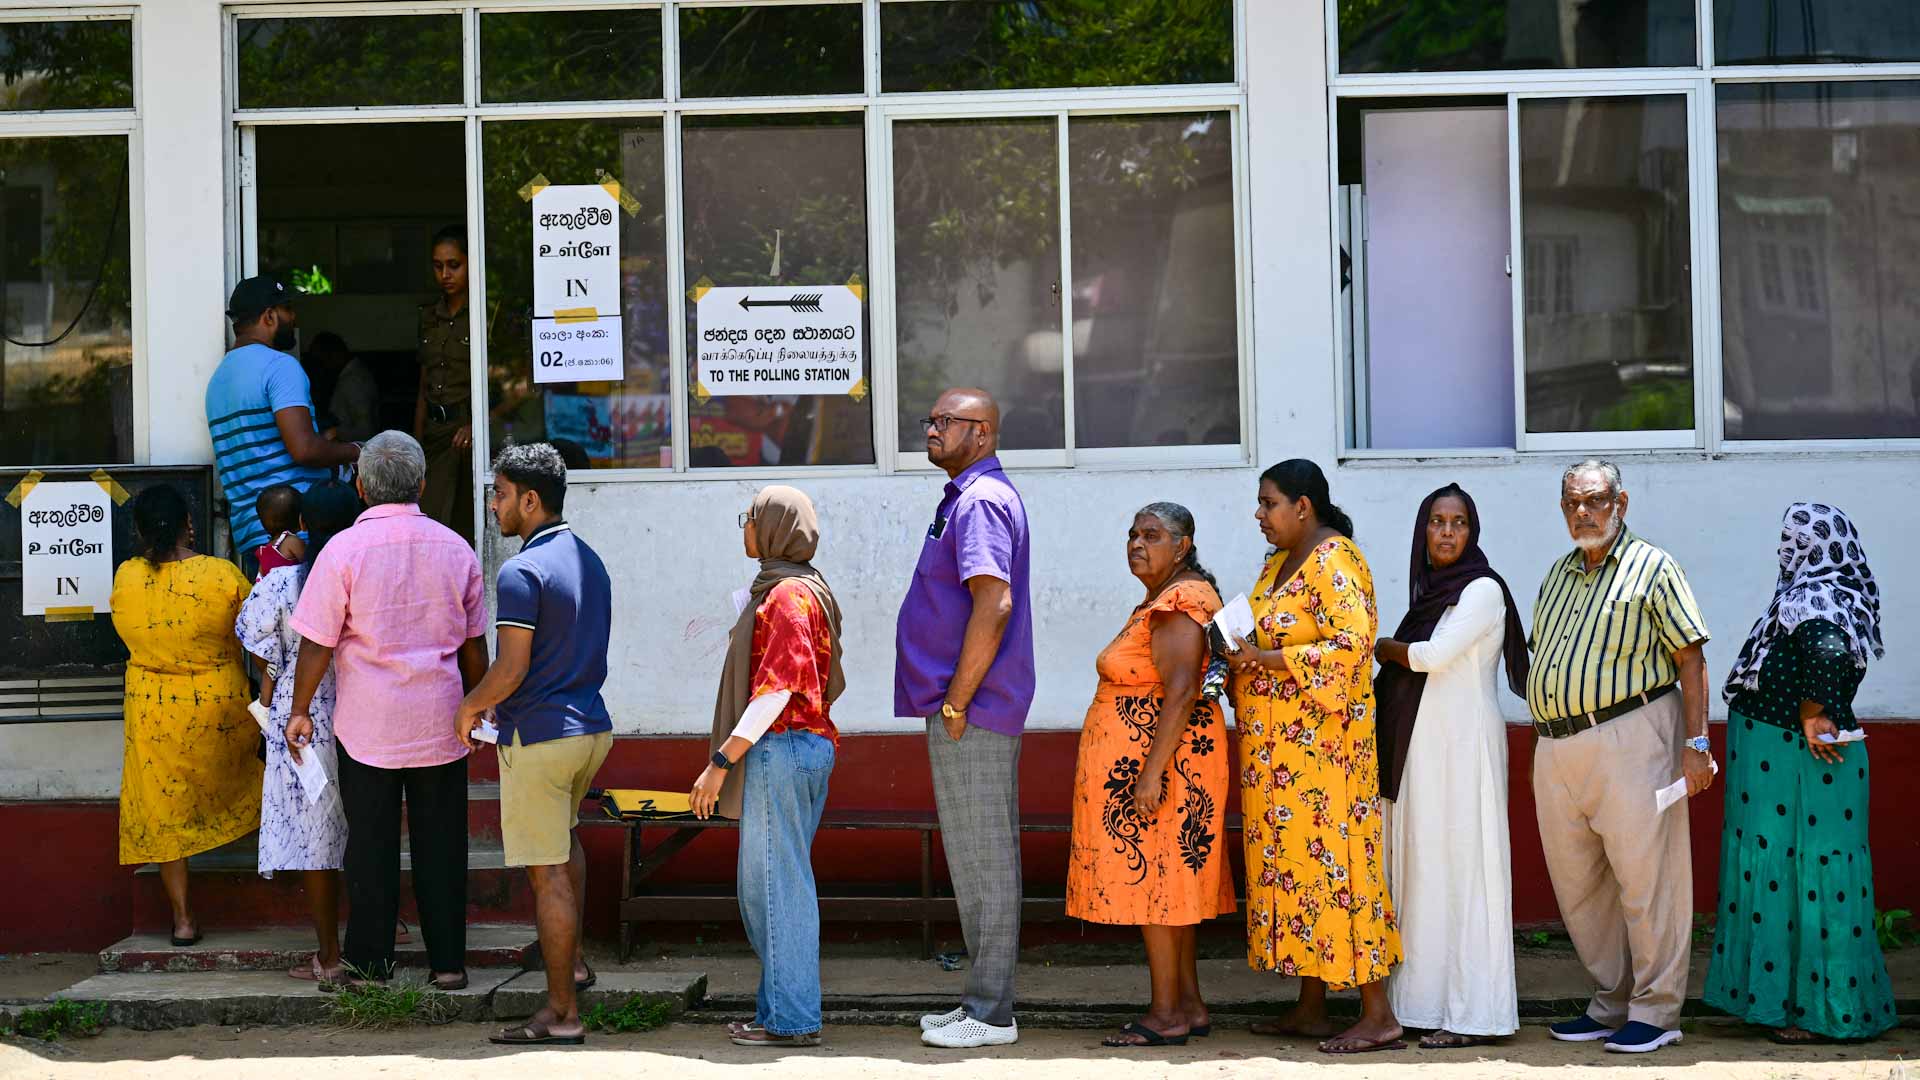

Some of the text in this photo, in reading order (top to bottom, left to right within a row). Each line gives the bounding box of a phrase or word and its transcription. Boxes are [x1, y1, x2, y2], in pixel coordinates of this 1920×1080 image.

[539, 207, 612, 231] ඇතුල්වීම
[539, 241, 611, 259] உள்ளே
[566, 279, 588, 297] IN
[539, 329, 572, 341] ශාලා
[704, 327, 748, 345] ඡන්දය
[754, 328, 786, 344] දෙන
[540, 351, 563, 367] 02
[702, 348, 773, 363] வாக்கெடுப்பு
[709, 368, 849, 382] TO THE POLLING STATION
[29, 504, 104, 528] ඇතුල්වීම
[29, 538, 104, 556] உள்ளே
[56, 577, 80, 595] IN
